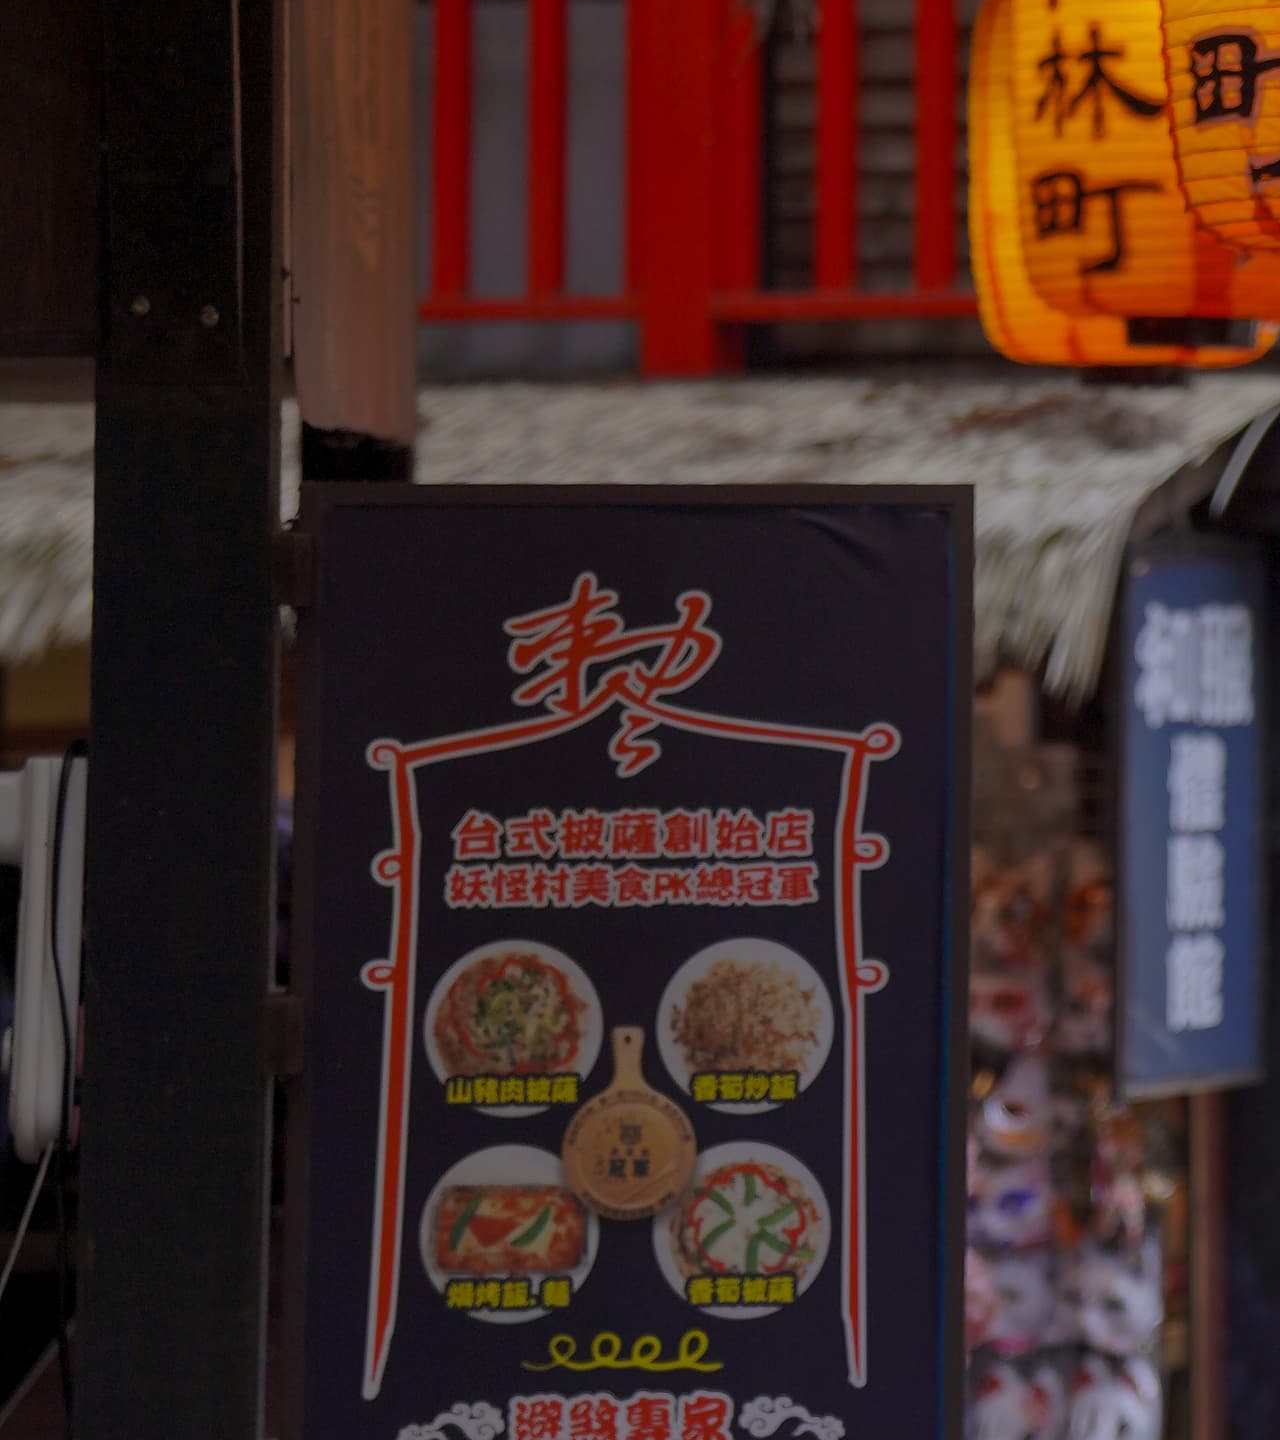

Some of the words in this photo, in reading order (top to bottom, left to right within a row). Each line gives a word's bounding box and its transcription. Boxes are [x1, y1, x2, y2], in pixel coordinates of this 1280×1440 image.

[452, 809, 813, 859] 台式披薩創始店
[446, 862, 818, 907] 妖怪村美食PK總冠軍
